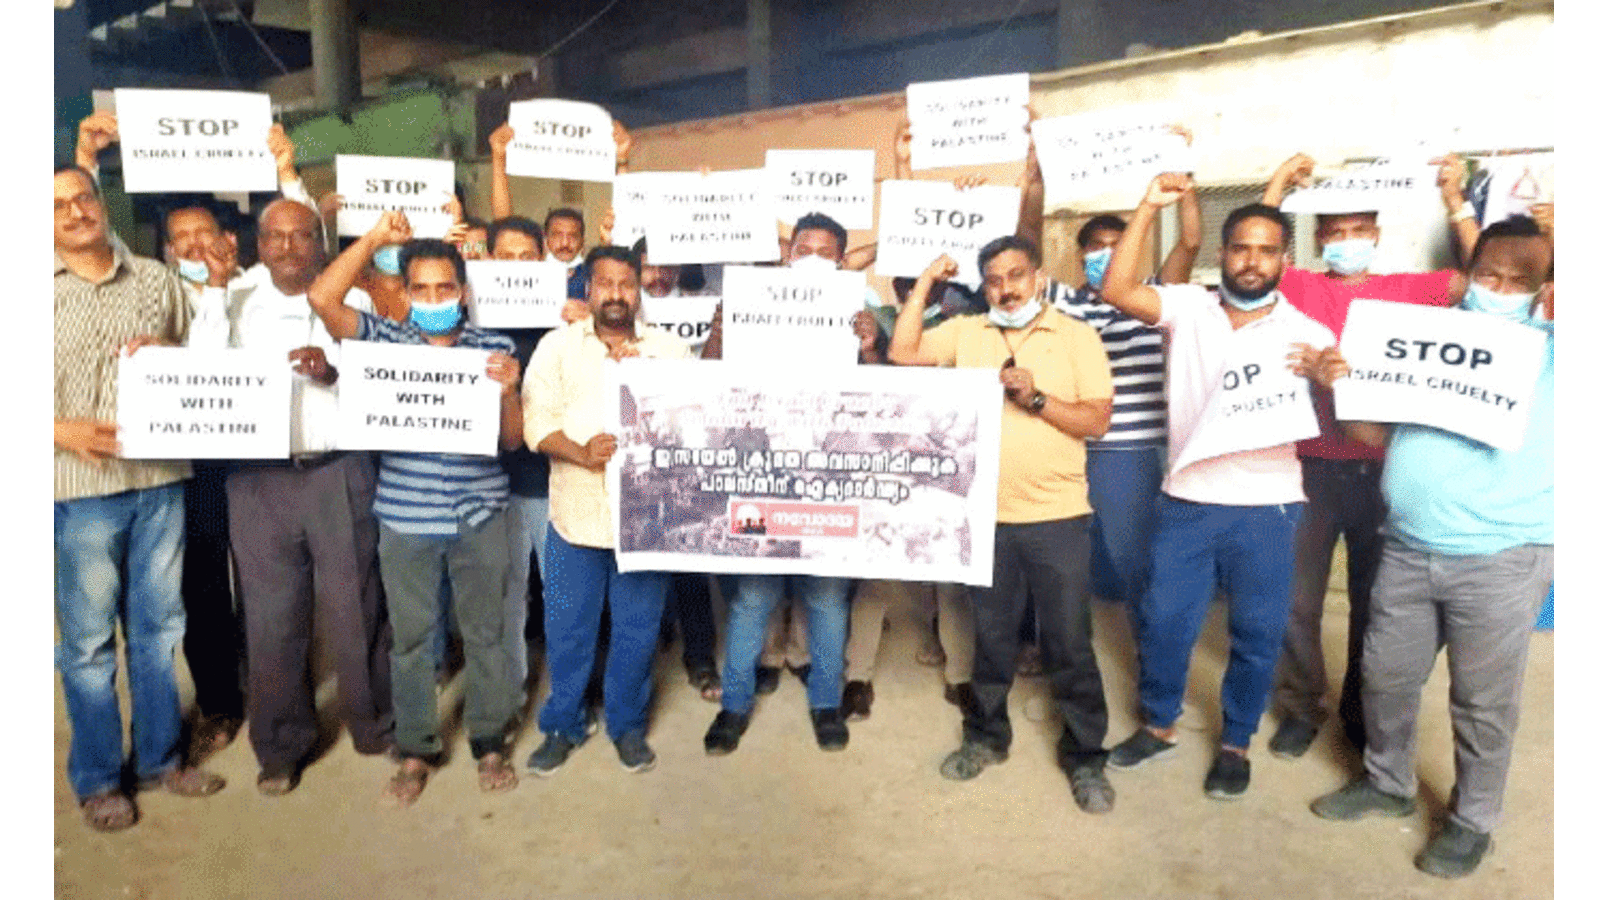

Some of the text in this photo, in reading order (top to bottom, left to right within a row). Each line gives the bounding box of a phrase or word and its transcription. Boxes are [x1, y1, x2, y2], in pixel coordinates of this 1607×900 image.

[157, 117, 240, 136] STOP
[533, 120, 593, 139] STOP
[365, 179, 428, 195] STOP
[790, 171, 848, 187] STOP
[914, 206, 984, 230] STOP
[1384, 338, 1494, 370] STOP
[145, 374, 267, 388] SOLIDARITY
[363, 366, 481, 386] SOLIDARITY
[396, 392, 446, 406] WITH
[1347, 368, 1518, 411] ISRAEL CRUELTY
[179, 397, 234, 410] WITH
[149, 422, 258, 434] PALASTINE
[366, 413, 473, 432] PALASTINE
